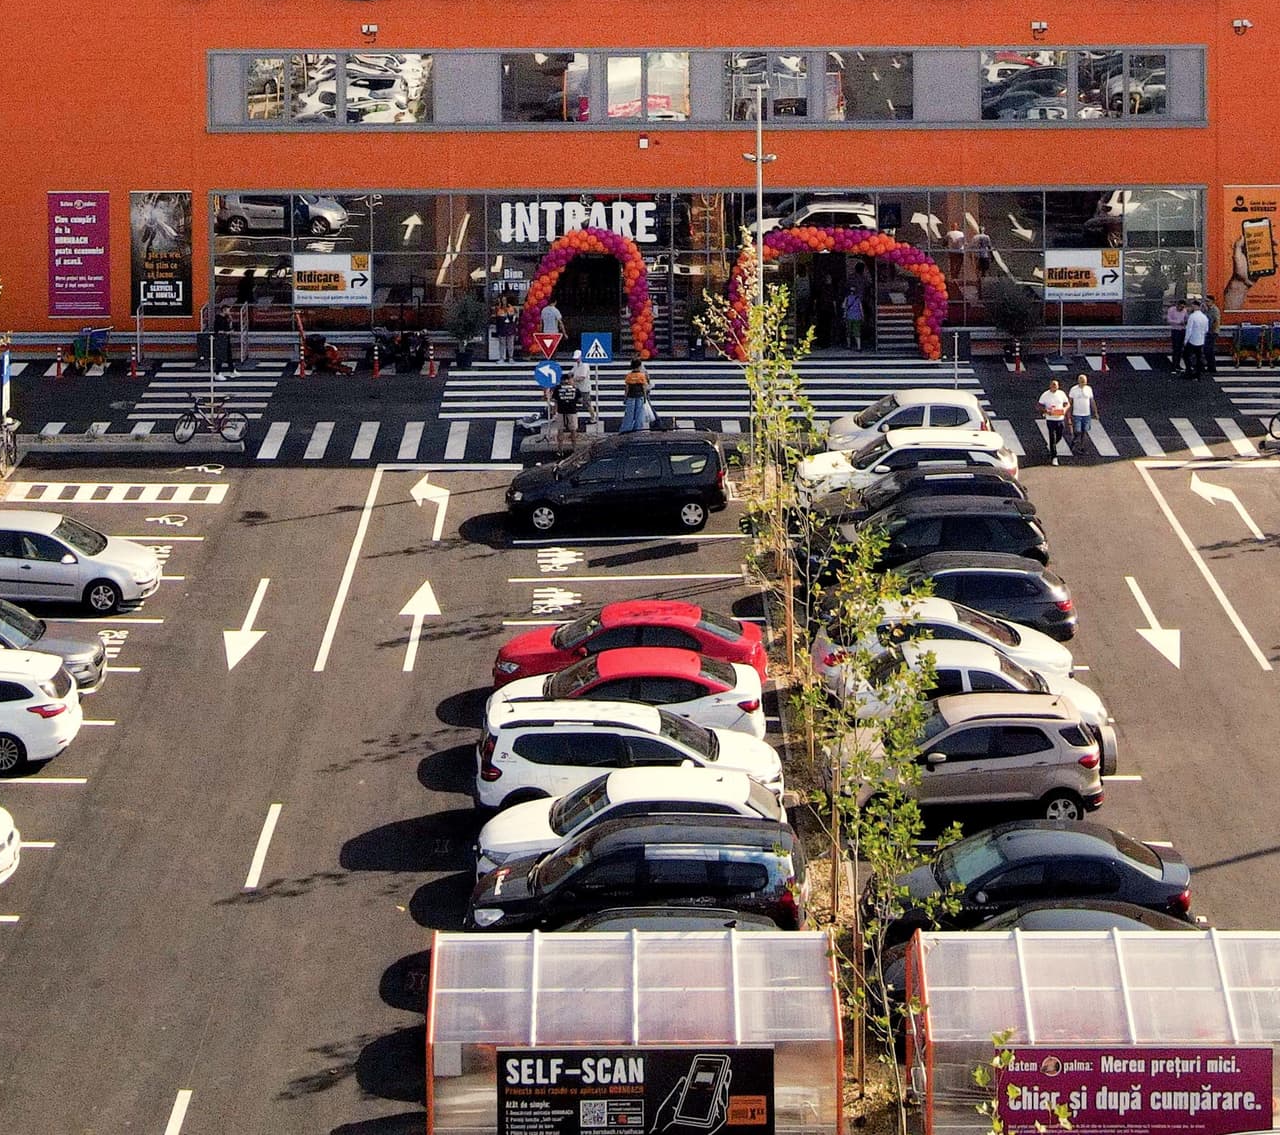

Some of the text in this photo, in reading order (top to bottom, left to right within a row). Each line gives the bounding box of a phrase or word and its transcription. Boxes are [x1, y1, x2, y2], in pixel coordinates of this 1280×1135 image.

[500, 201, 658, 243] INTRARE
[296, 271, 340, 283] Ridicare
[503, 268, 524, 279] Bine
[1047, 268, 1090, 280] Ridicare
[505, 1057, 644, 1085] SELF-SCAN
[1063, 1061, 1094, 1075] palma:
[1100, 1055, 1145, 1073] Mereu
[1150, 1055, 1201, 1078] prețuri
[1206, 1055, 1241, 1073] mici.
[1070, 1085, 1087, 1117] și
[1095, 1083, 1142, 1116] după
[1150, 1083, 1262, 1116] cumpărare.
